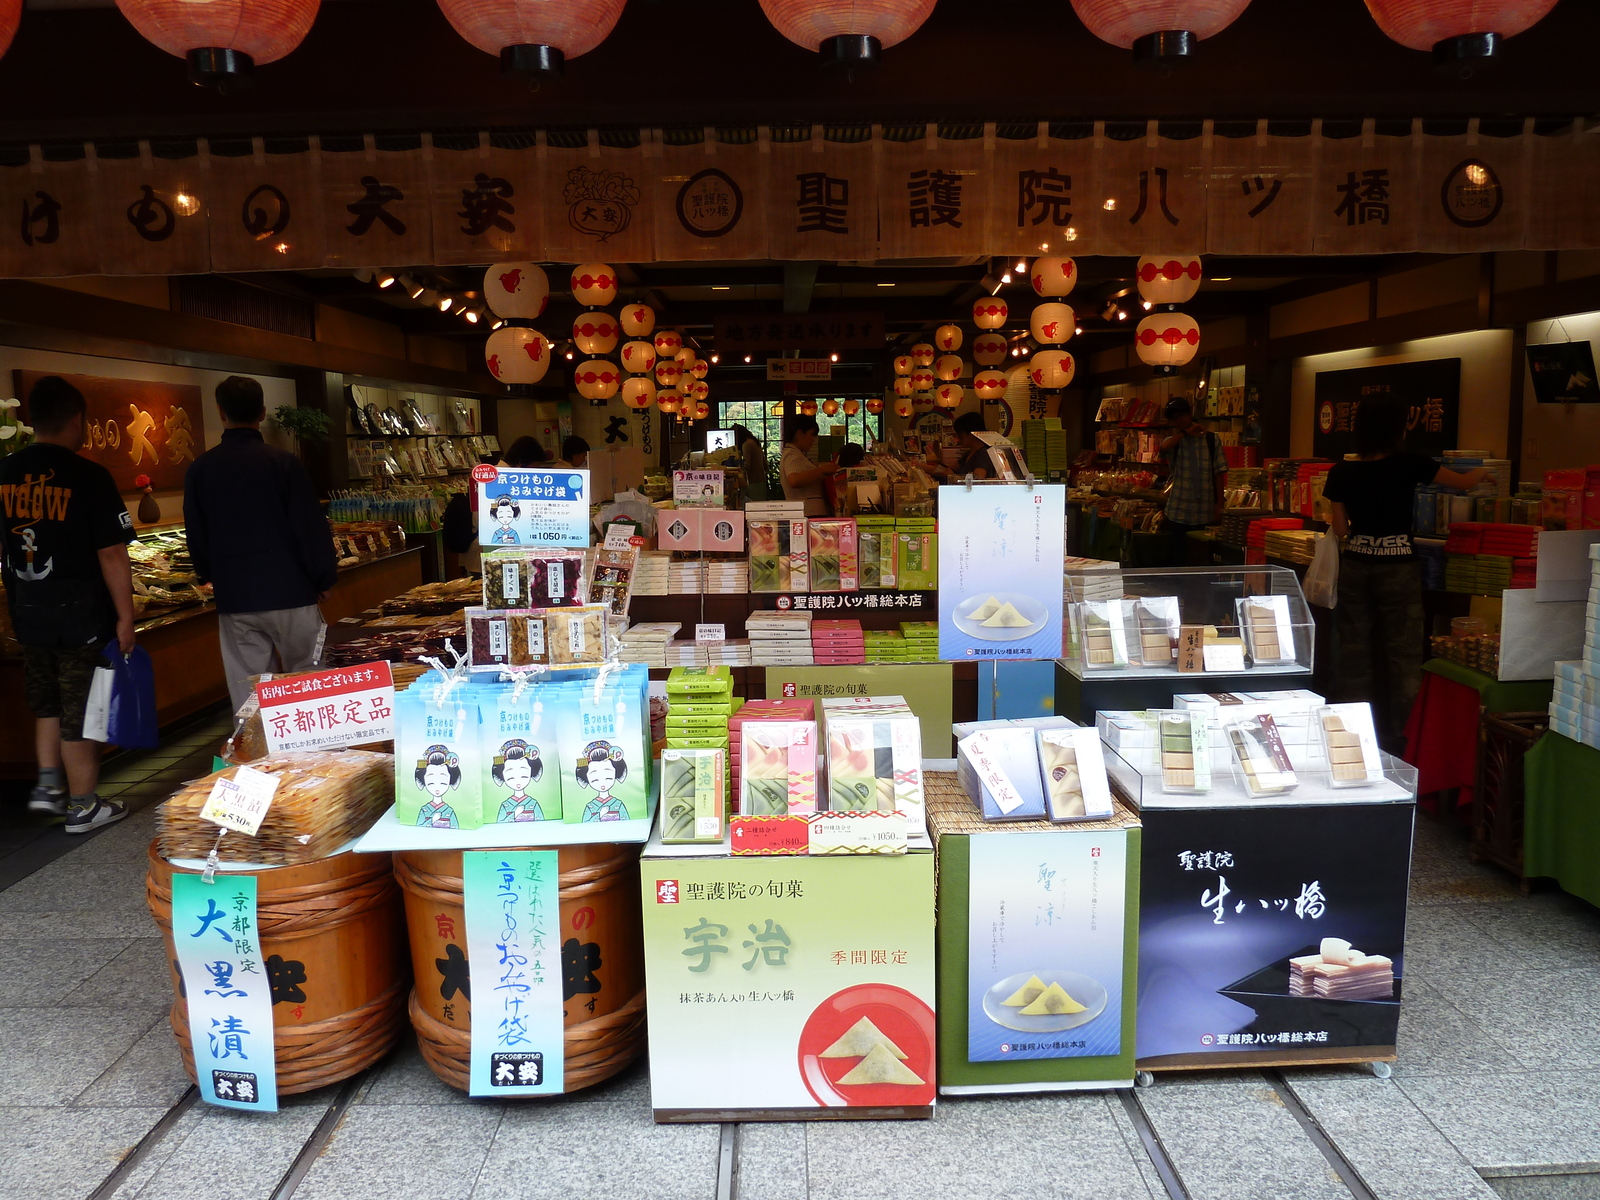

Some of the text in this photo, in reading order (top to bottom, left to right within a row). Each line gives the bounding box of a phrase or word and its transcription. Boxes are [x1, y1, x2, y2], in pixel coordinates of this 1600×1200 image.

[581, 206, 619, 225] 大安
[497, 474, 554, 486] 京つけもの
[686, 472, 720, 481] 京の味日記
[510, 485, 566, 498] おみやげ袋
[261, 669, 379, 700] 店内にご試食ございます。
[800, 684, 868, 696] 聖護院の旬菓
[269, 695, 392, 739] 京都限定品
[426, 715, 454, 728] 京つけもの
[500, 710, 530, 722] 京つけもの
[583, 713, 614, 725] 京つけもの
[426, 728, 454, 738] おみやげ袋
[500, 723, 531, 732] おみやげ袋
[583, 725, 615, 735] おみやげ袋
[278, 727, 390, 751] 京都でしかお求めいただけない限定品です。
[968, 741, 1014, 802] 夏季限定
[873, 832, 896, 841] ¥1050
[1177, 850, 1234, 871] 聖護院
[658, 879, 804, 903] 聖 聖護院の旬菓
[435, 913, 456, 939] 京
[523, 861, 546, 986] 選ばれた人気の五品
[571, 906, 596, 931] の
[232, 892, 260, 975] 京都限定
[681, 917, 792, 973] 宇治
[831, 949, 908, 966] 季間限定
[190, 898, 251, 1061] 大黒漬
[495, 1061, 539, 1083] 大安
[217, 1078, 254, 1099] 大安
